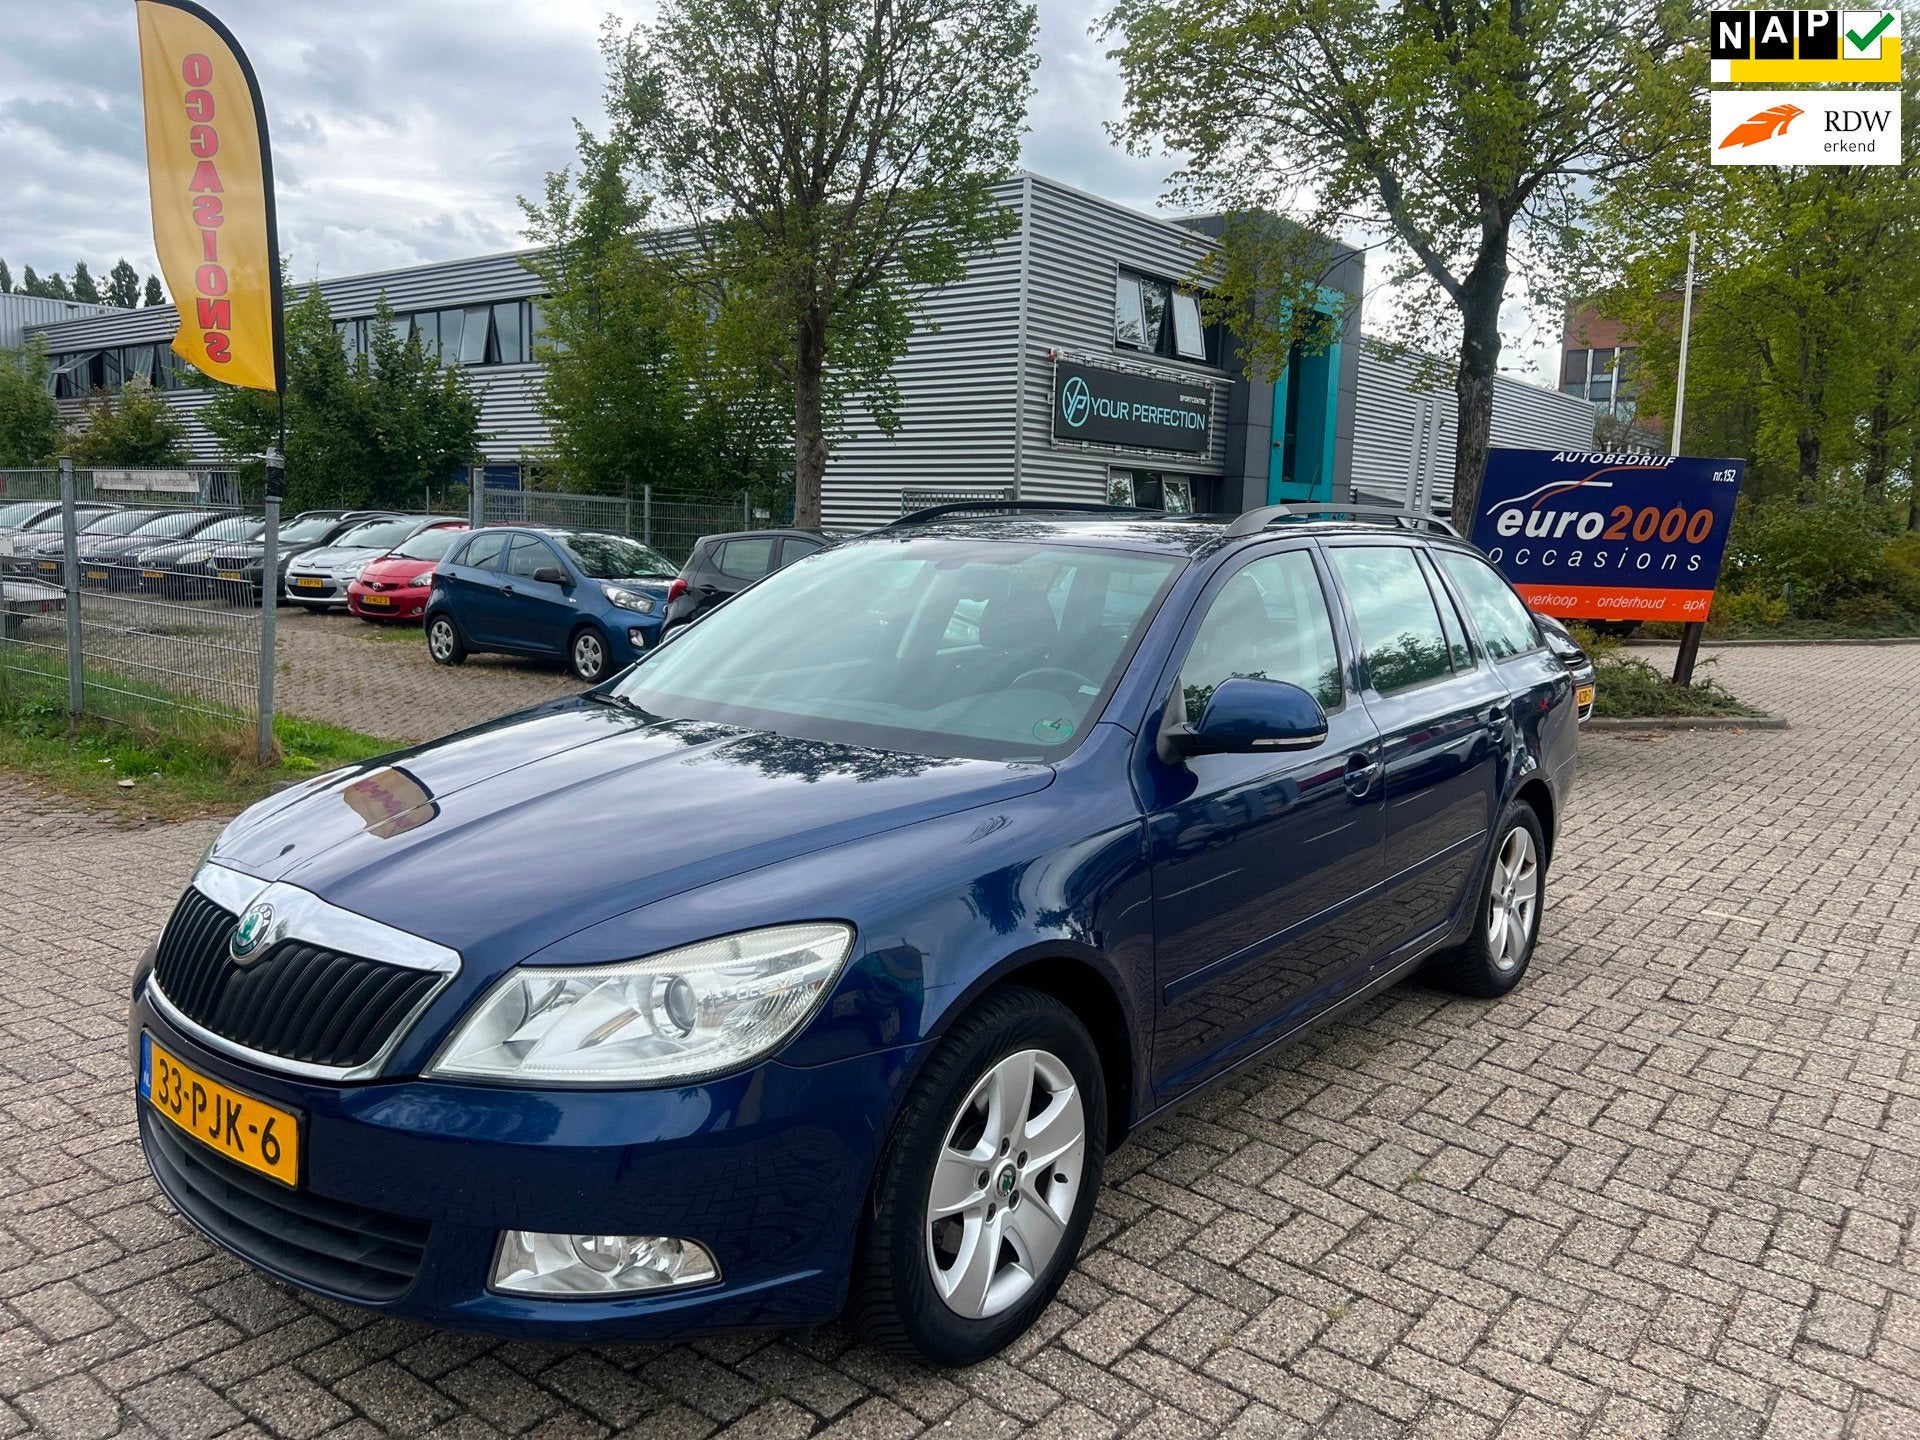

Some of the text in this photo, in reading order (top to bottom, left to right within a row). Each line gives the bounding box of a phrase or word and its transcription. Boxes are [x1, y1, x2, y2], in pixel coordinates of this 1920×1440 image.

[1091, 397, 1206, 431] YOUR PERFECTION
[1551, 451, 1676, 467] AUTOBEDRIJF
[1712, 469, 1736, 482] nr.152
[1496, 504, 1714, 544] euro2000
[1489, 546, 1701, 571] occasions
[1527, 593, 1578, 608] verkoop
[1597, 597, 1666, 610] onderhoud
[1683, 598, 1706, 611] apk
[158, 1058, 281, 1166] 33-PJK-6
